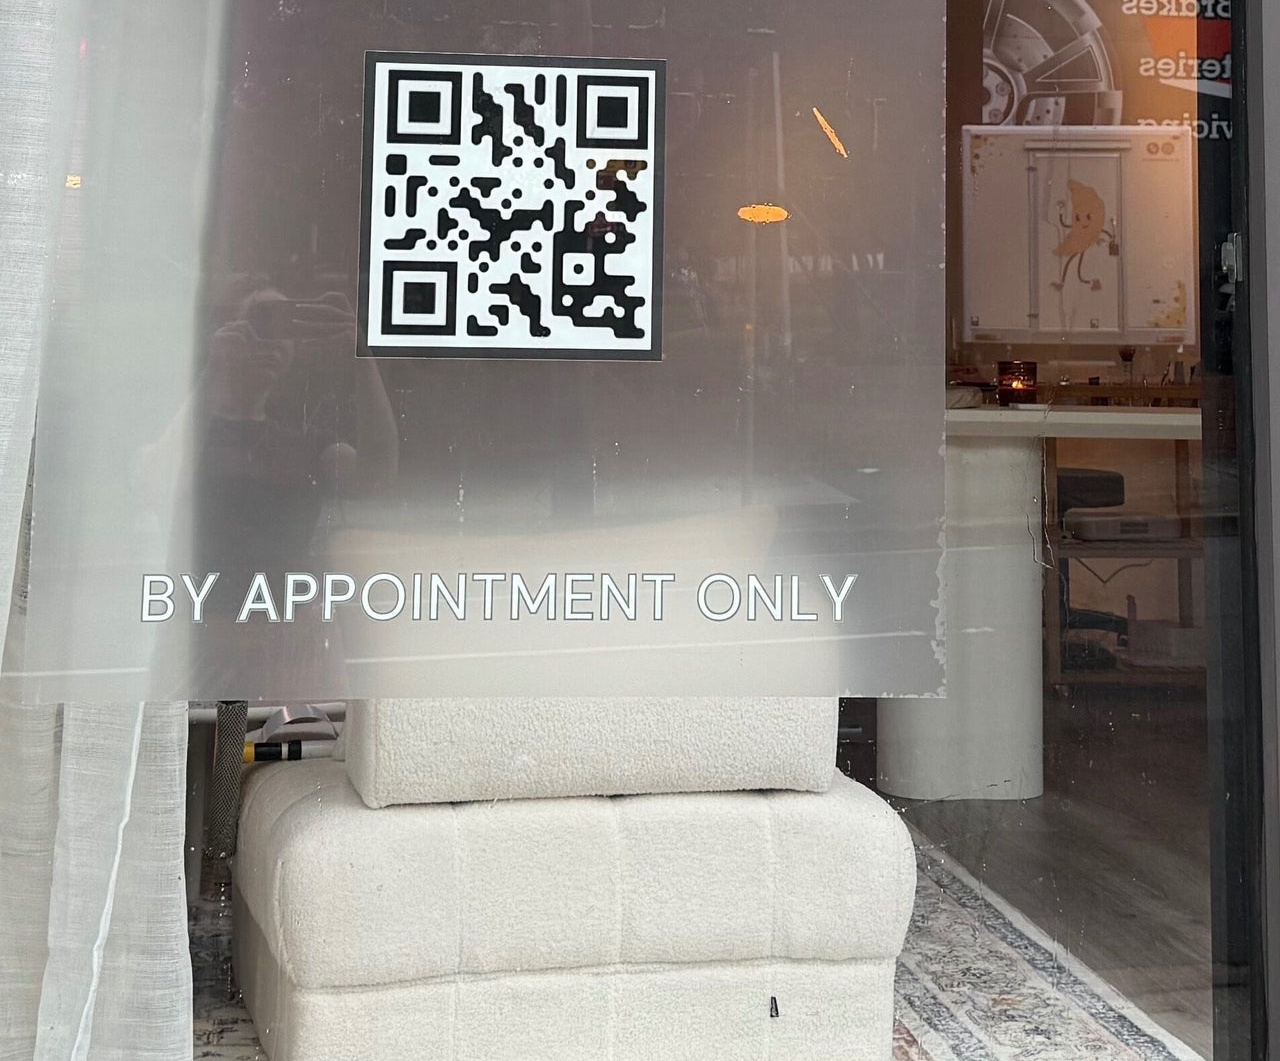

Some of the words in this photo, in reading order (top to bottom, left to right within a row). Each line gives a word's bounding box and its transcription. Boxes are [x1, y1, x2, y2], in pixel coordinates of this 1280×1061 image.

[140, 572, 220, 624] BY
[236, 571, 676, 623] APPOINTMENT
[696, 571, 858, 623] ONLY
